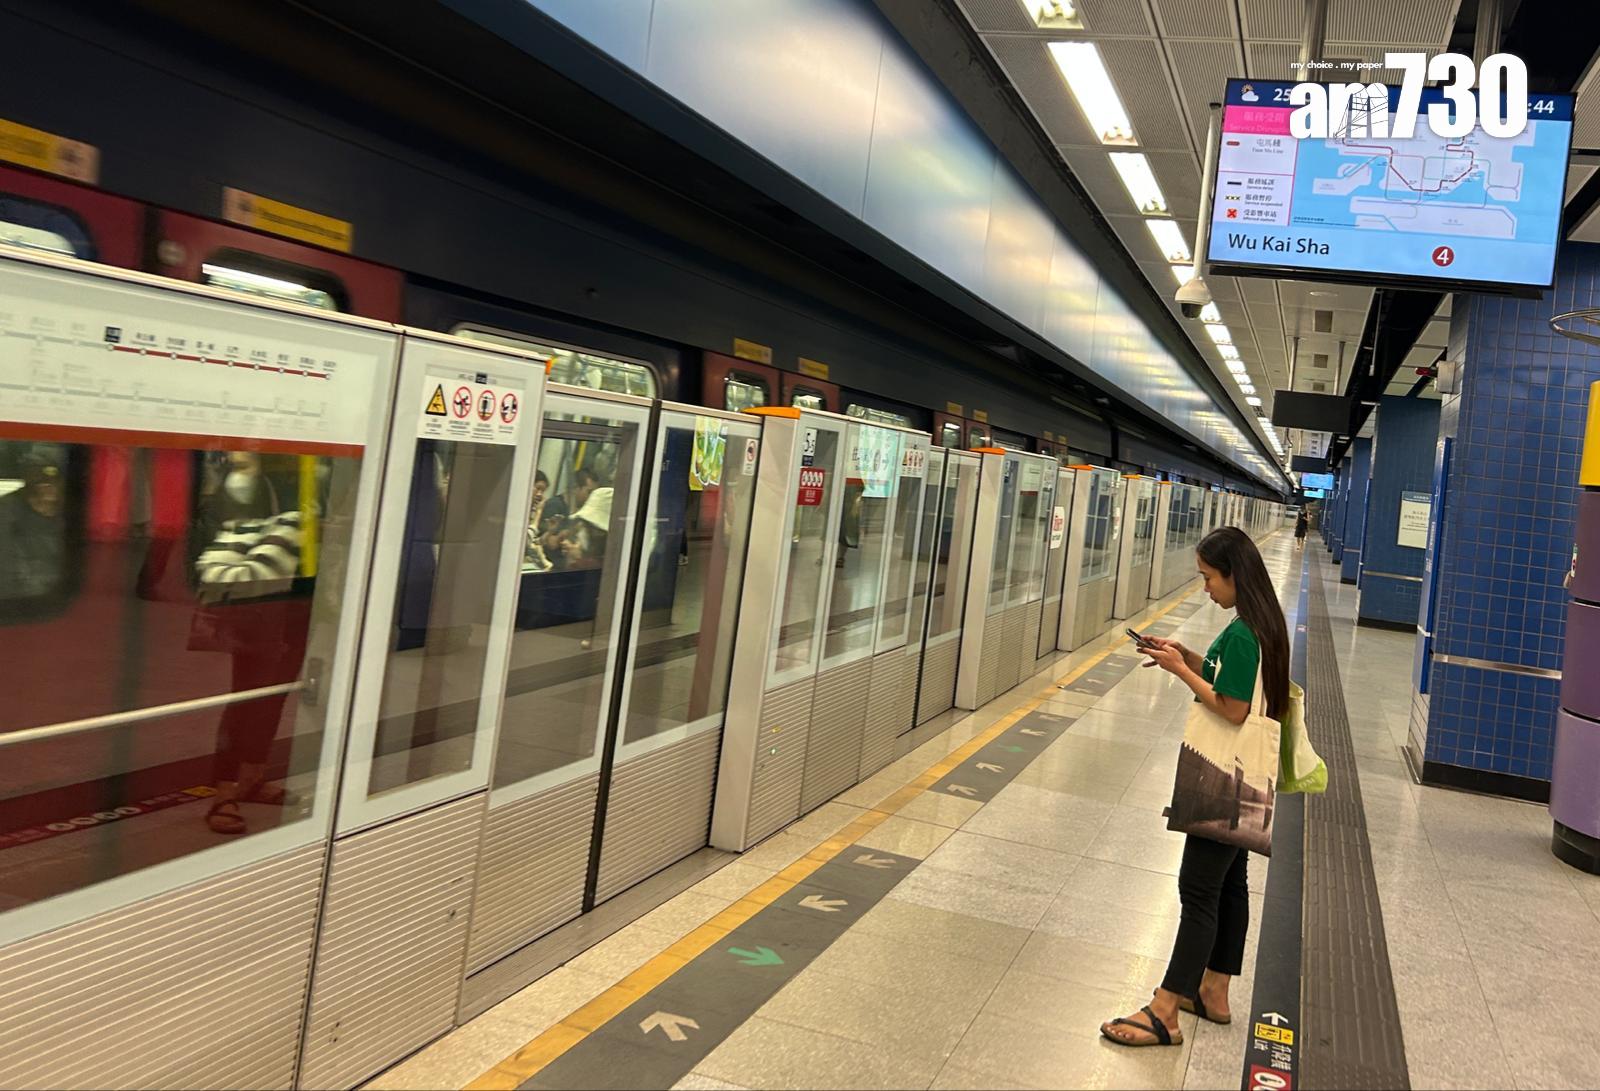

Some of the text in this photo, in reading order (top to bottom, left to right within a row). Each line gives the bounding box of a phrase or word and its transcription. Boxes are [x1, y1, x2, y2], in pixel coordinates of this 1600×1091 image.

[1228, 233, 1330, 255] Wu Kai Sha
[1436, 248, 1450, 264] 4
